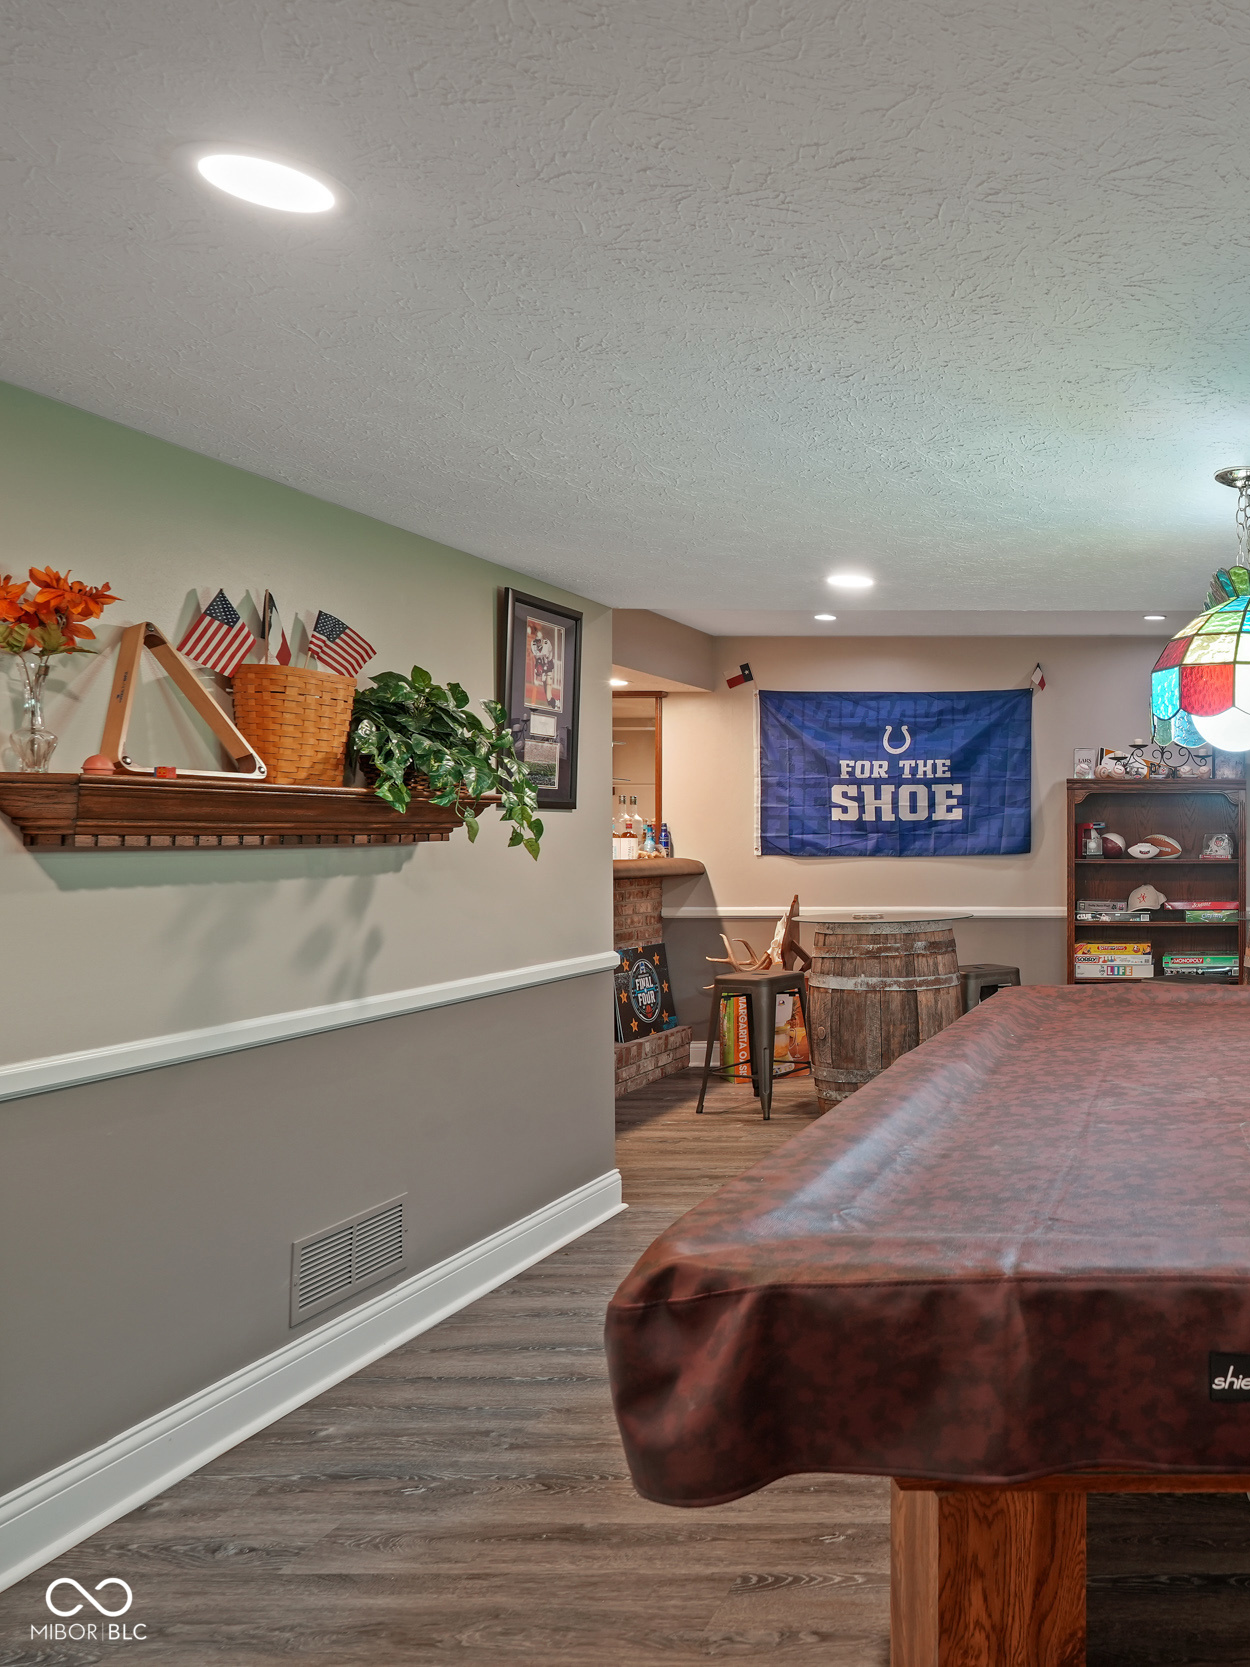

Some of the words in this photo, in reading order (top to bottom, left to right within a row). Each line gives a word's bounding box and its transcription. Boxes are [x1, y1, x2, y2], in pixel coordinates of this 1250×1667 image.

[839, 759, 889, 779] FOR
[898, 759, 951, 778] THE
[830, 784, 963, 822] SHOE
[1107, 966, 1132, 976] LIFE
[635, 975, 654, 991] FINAL
[638, 992, 656, 1007] FOUR
[738, 995, 748, 1050] MARGARITA
